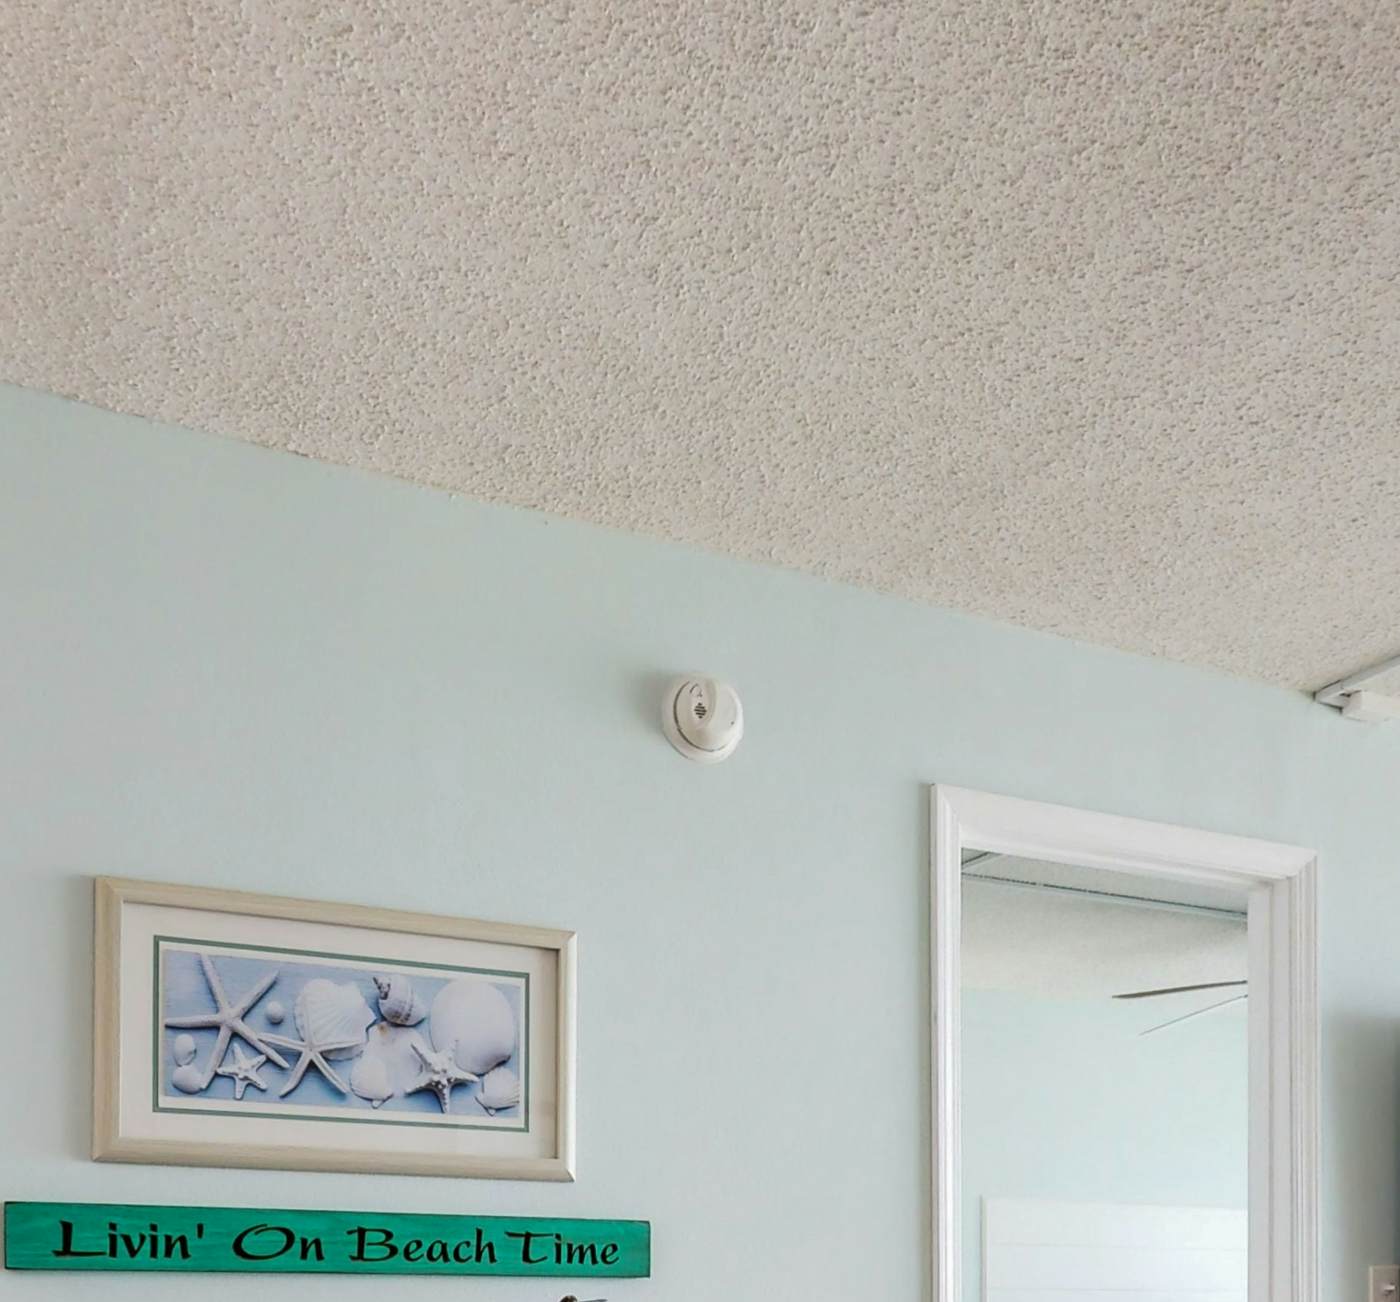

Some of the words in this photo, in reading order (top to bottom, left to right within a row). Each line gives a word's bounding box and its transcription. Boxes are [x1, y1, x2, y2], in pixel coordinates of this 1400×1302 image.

[52, 1220, 205, 1260] Livin'
[231, 1223, 326, 1262] On
[346, 1226, 498, 1264] Beach
[505, 1231, 619, 1266] Time
